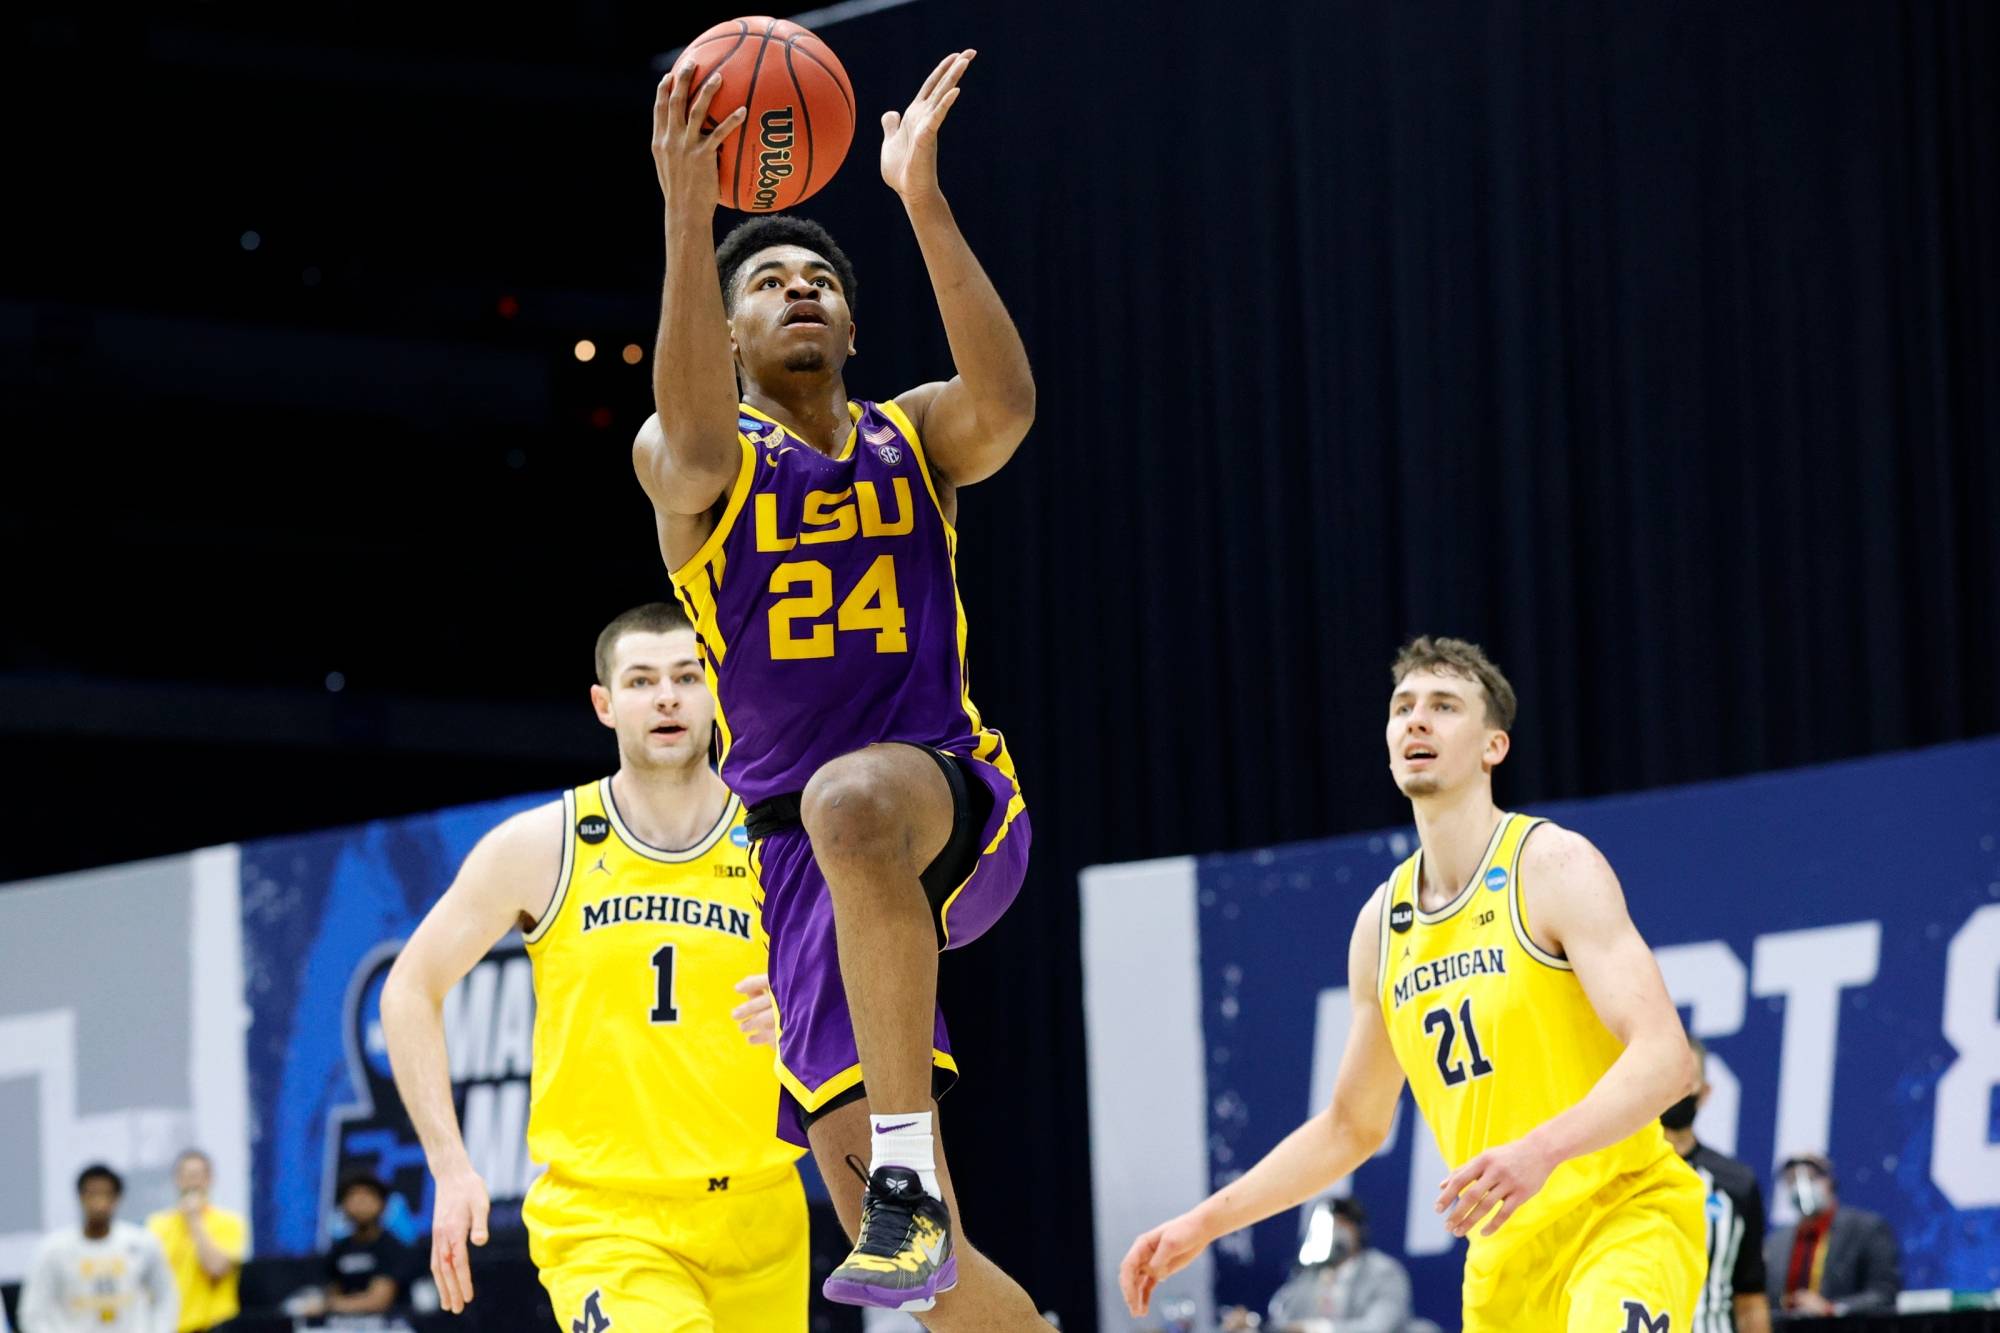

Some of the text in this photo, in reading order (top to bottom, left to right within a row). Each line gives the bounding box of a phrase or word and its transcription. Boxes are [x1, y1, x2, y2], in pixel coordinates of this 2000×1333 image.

[753, 105, 794, 210] Wilson
[880, 447, 900, 464] SEC
[755, 477, 914, 552] LSU
[768, 554, 908, 660] 24
[580, 823, 606, 835] BLM
[582, 895, 751, 940] MICHIGAN
[1391, 910, 1412, 924] BLM
[650, 945, 678, 1023] 1
[1393, 948, 1506, 1009] MICHIGAN
[1423, 998, 1494, 1087] 21
[707, 1176, 730, 1192] M
[1620, 1300, 1670, 1333] M
